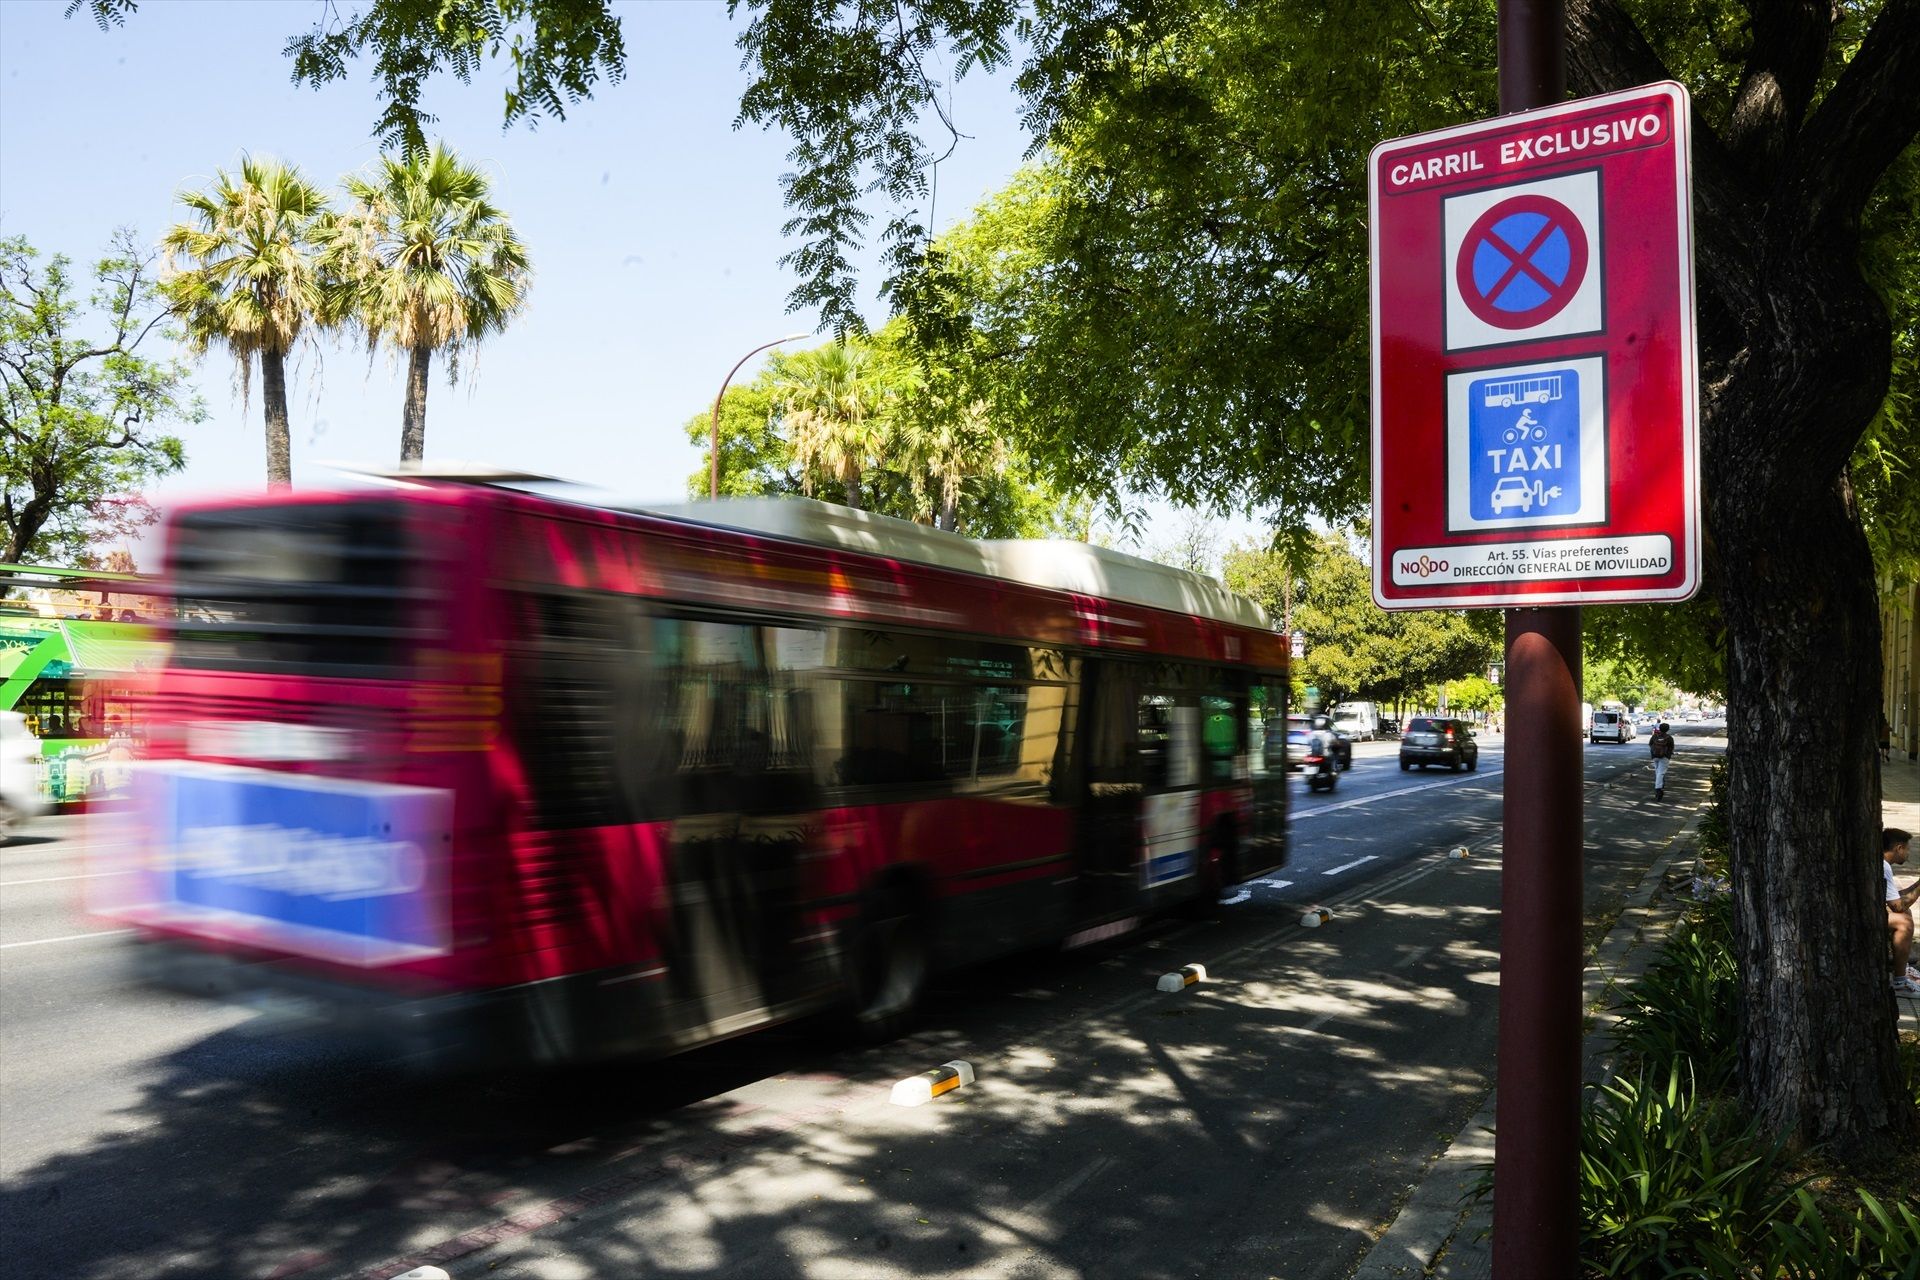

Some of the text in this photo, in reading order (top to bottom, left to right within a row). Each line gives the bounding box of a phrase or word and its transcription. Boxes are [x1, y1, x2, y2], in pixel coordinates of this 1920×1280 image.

[1391, 114, 1661, 186] CARRIL EXCLUSIVO
[1487, 444, 1562, 474] TAXI
[1487, 545, 1629, 561] Art. 55. Vías preferentes
[1453, 557, 1667, 577] DIRECCIÓN GENERAL DE MOVILIDAD
